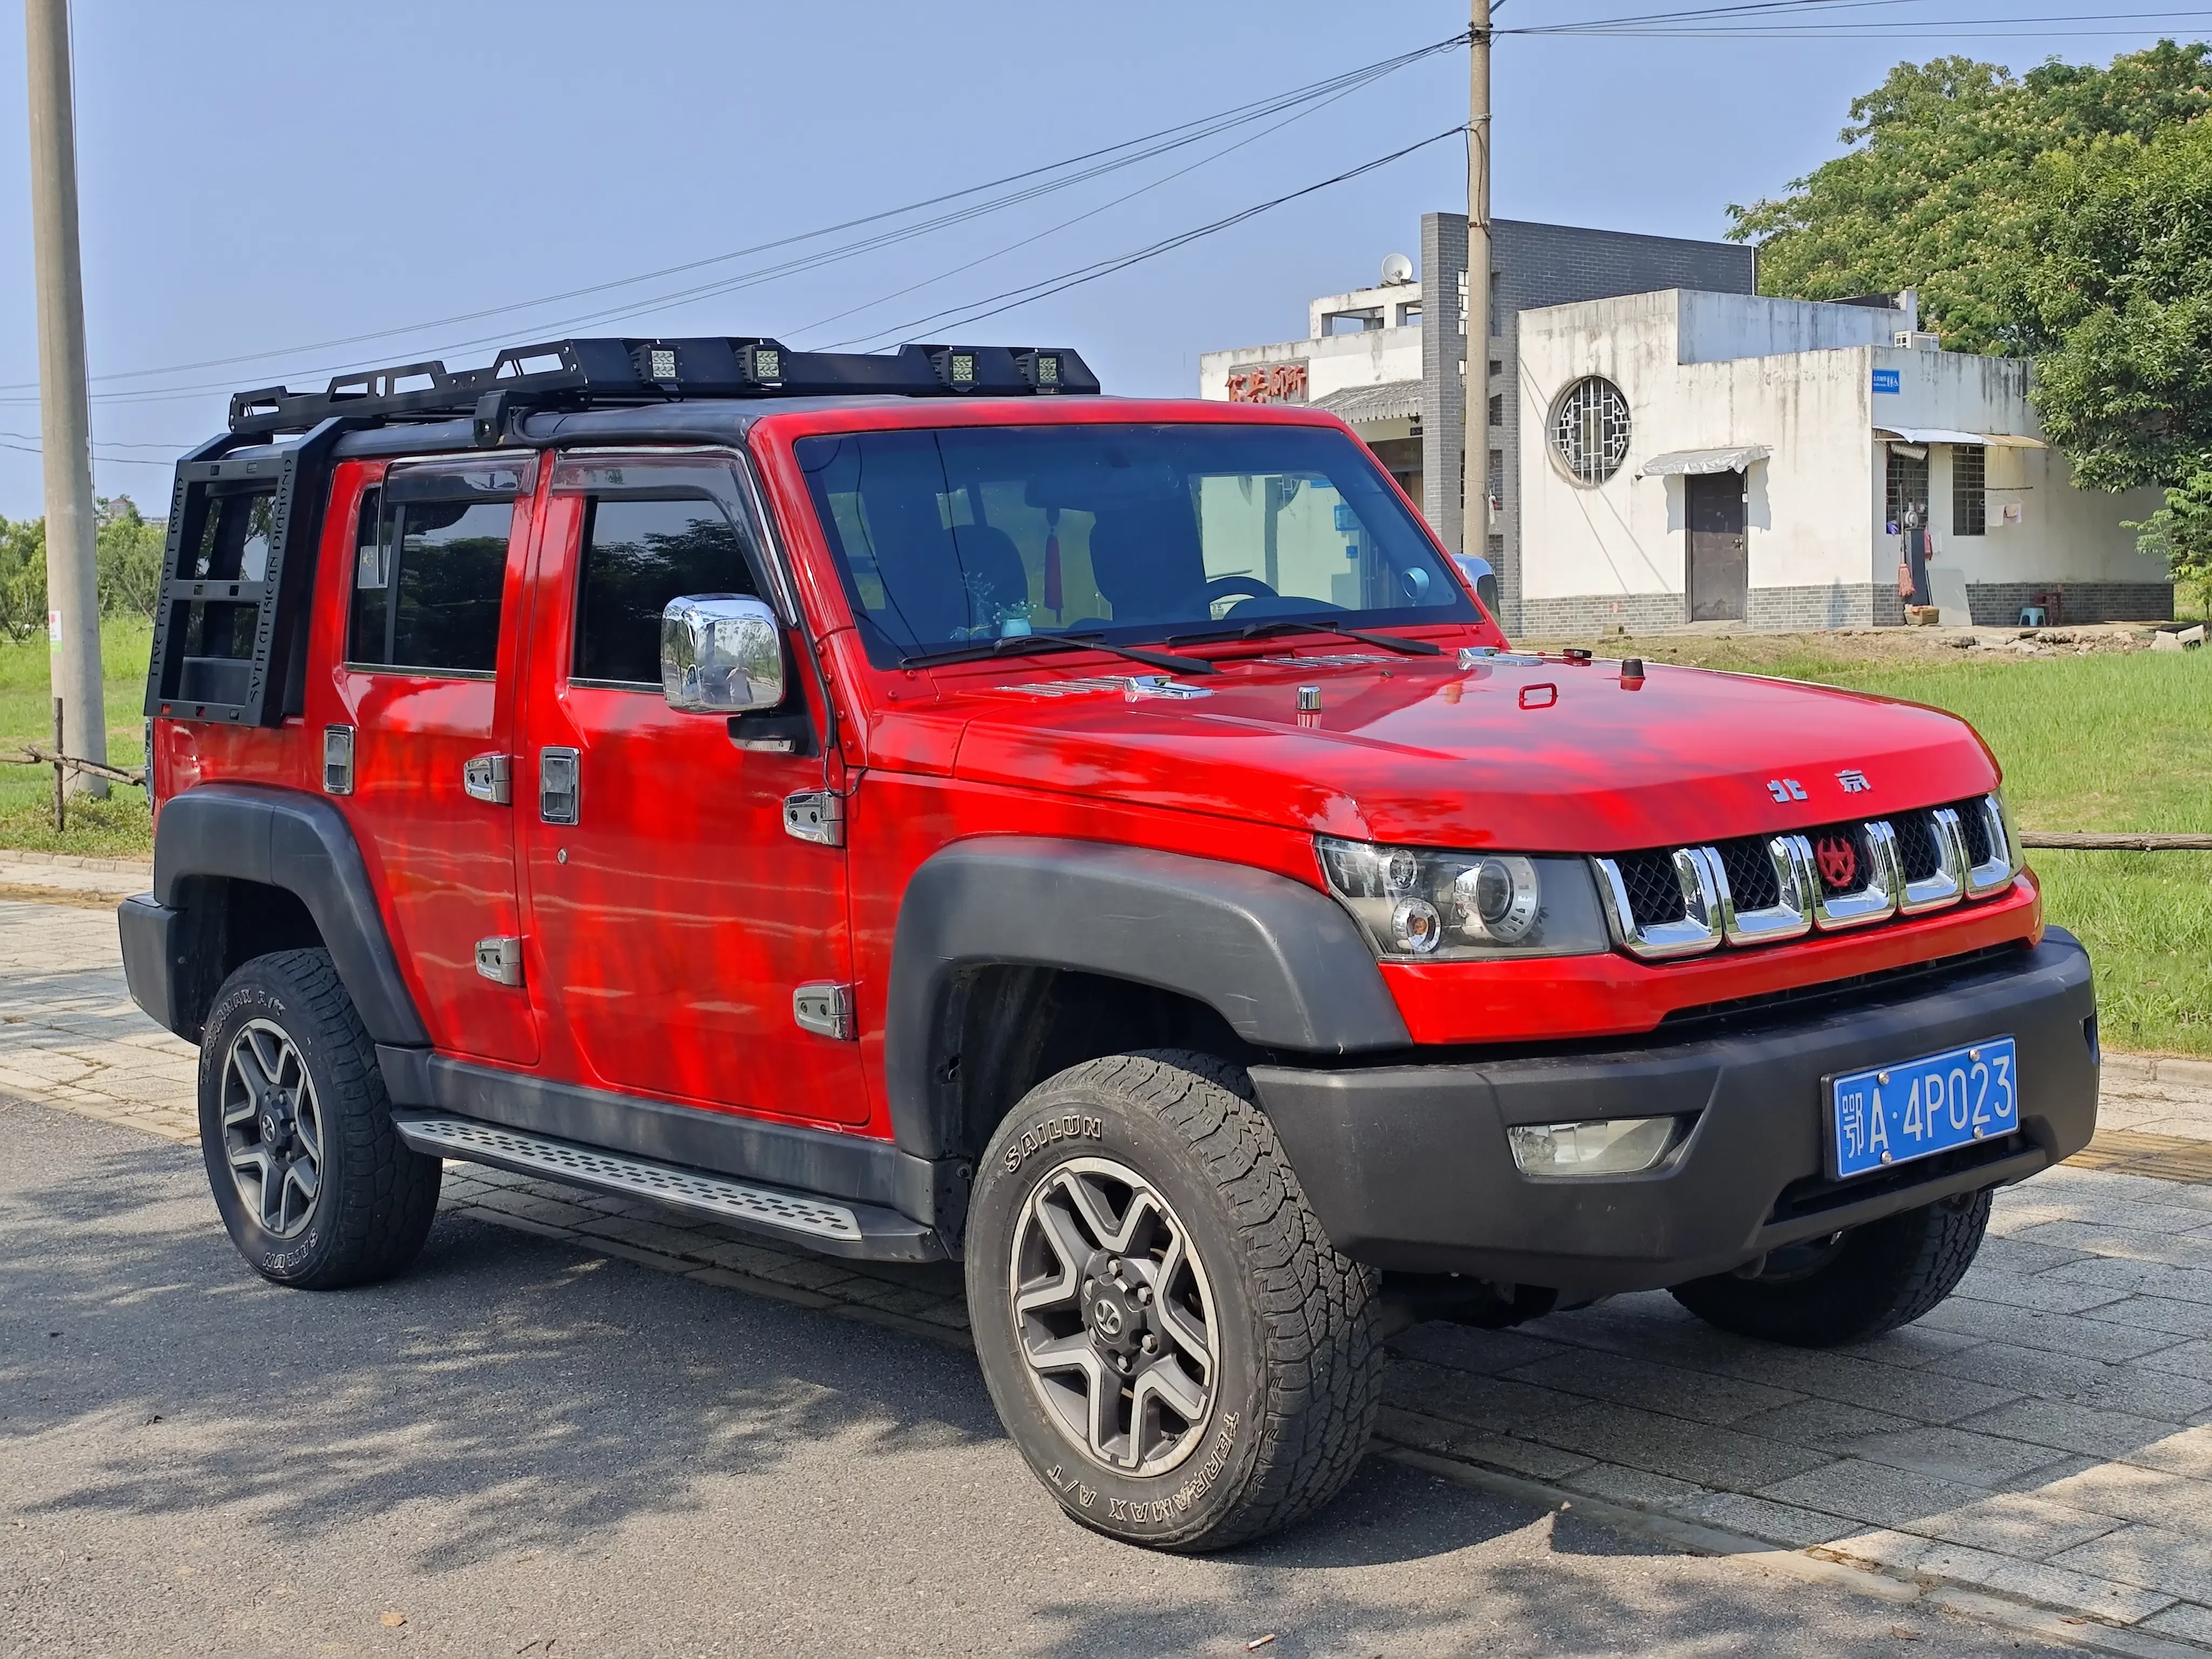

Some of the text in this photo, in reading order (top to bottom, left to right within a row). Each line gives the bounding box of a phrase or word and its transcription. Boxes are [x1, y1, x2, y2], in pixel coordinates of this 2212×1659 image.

[273, 459, 292, 550] DIAMOND
[1766, 768, 1872, 803] 北京
[1003, 1115, 1102, 1174] SAILUN
[1842, 1054, 2013, 1159] 鄂A·4P023
[1048, 1411, 1241, 1523] TERRAMAX A/T
